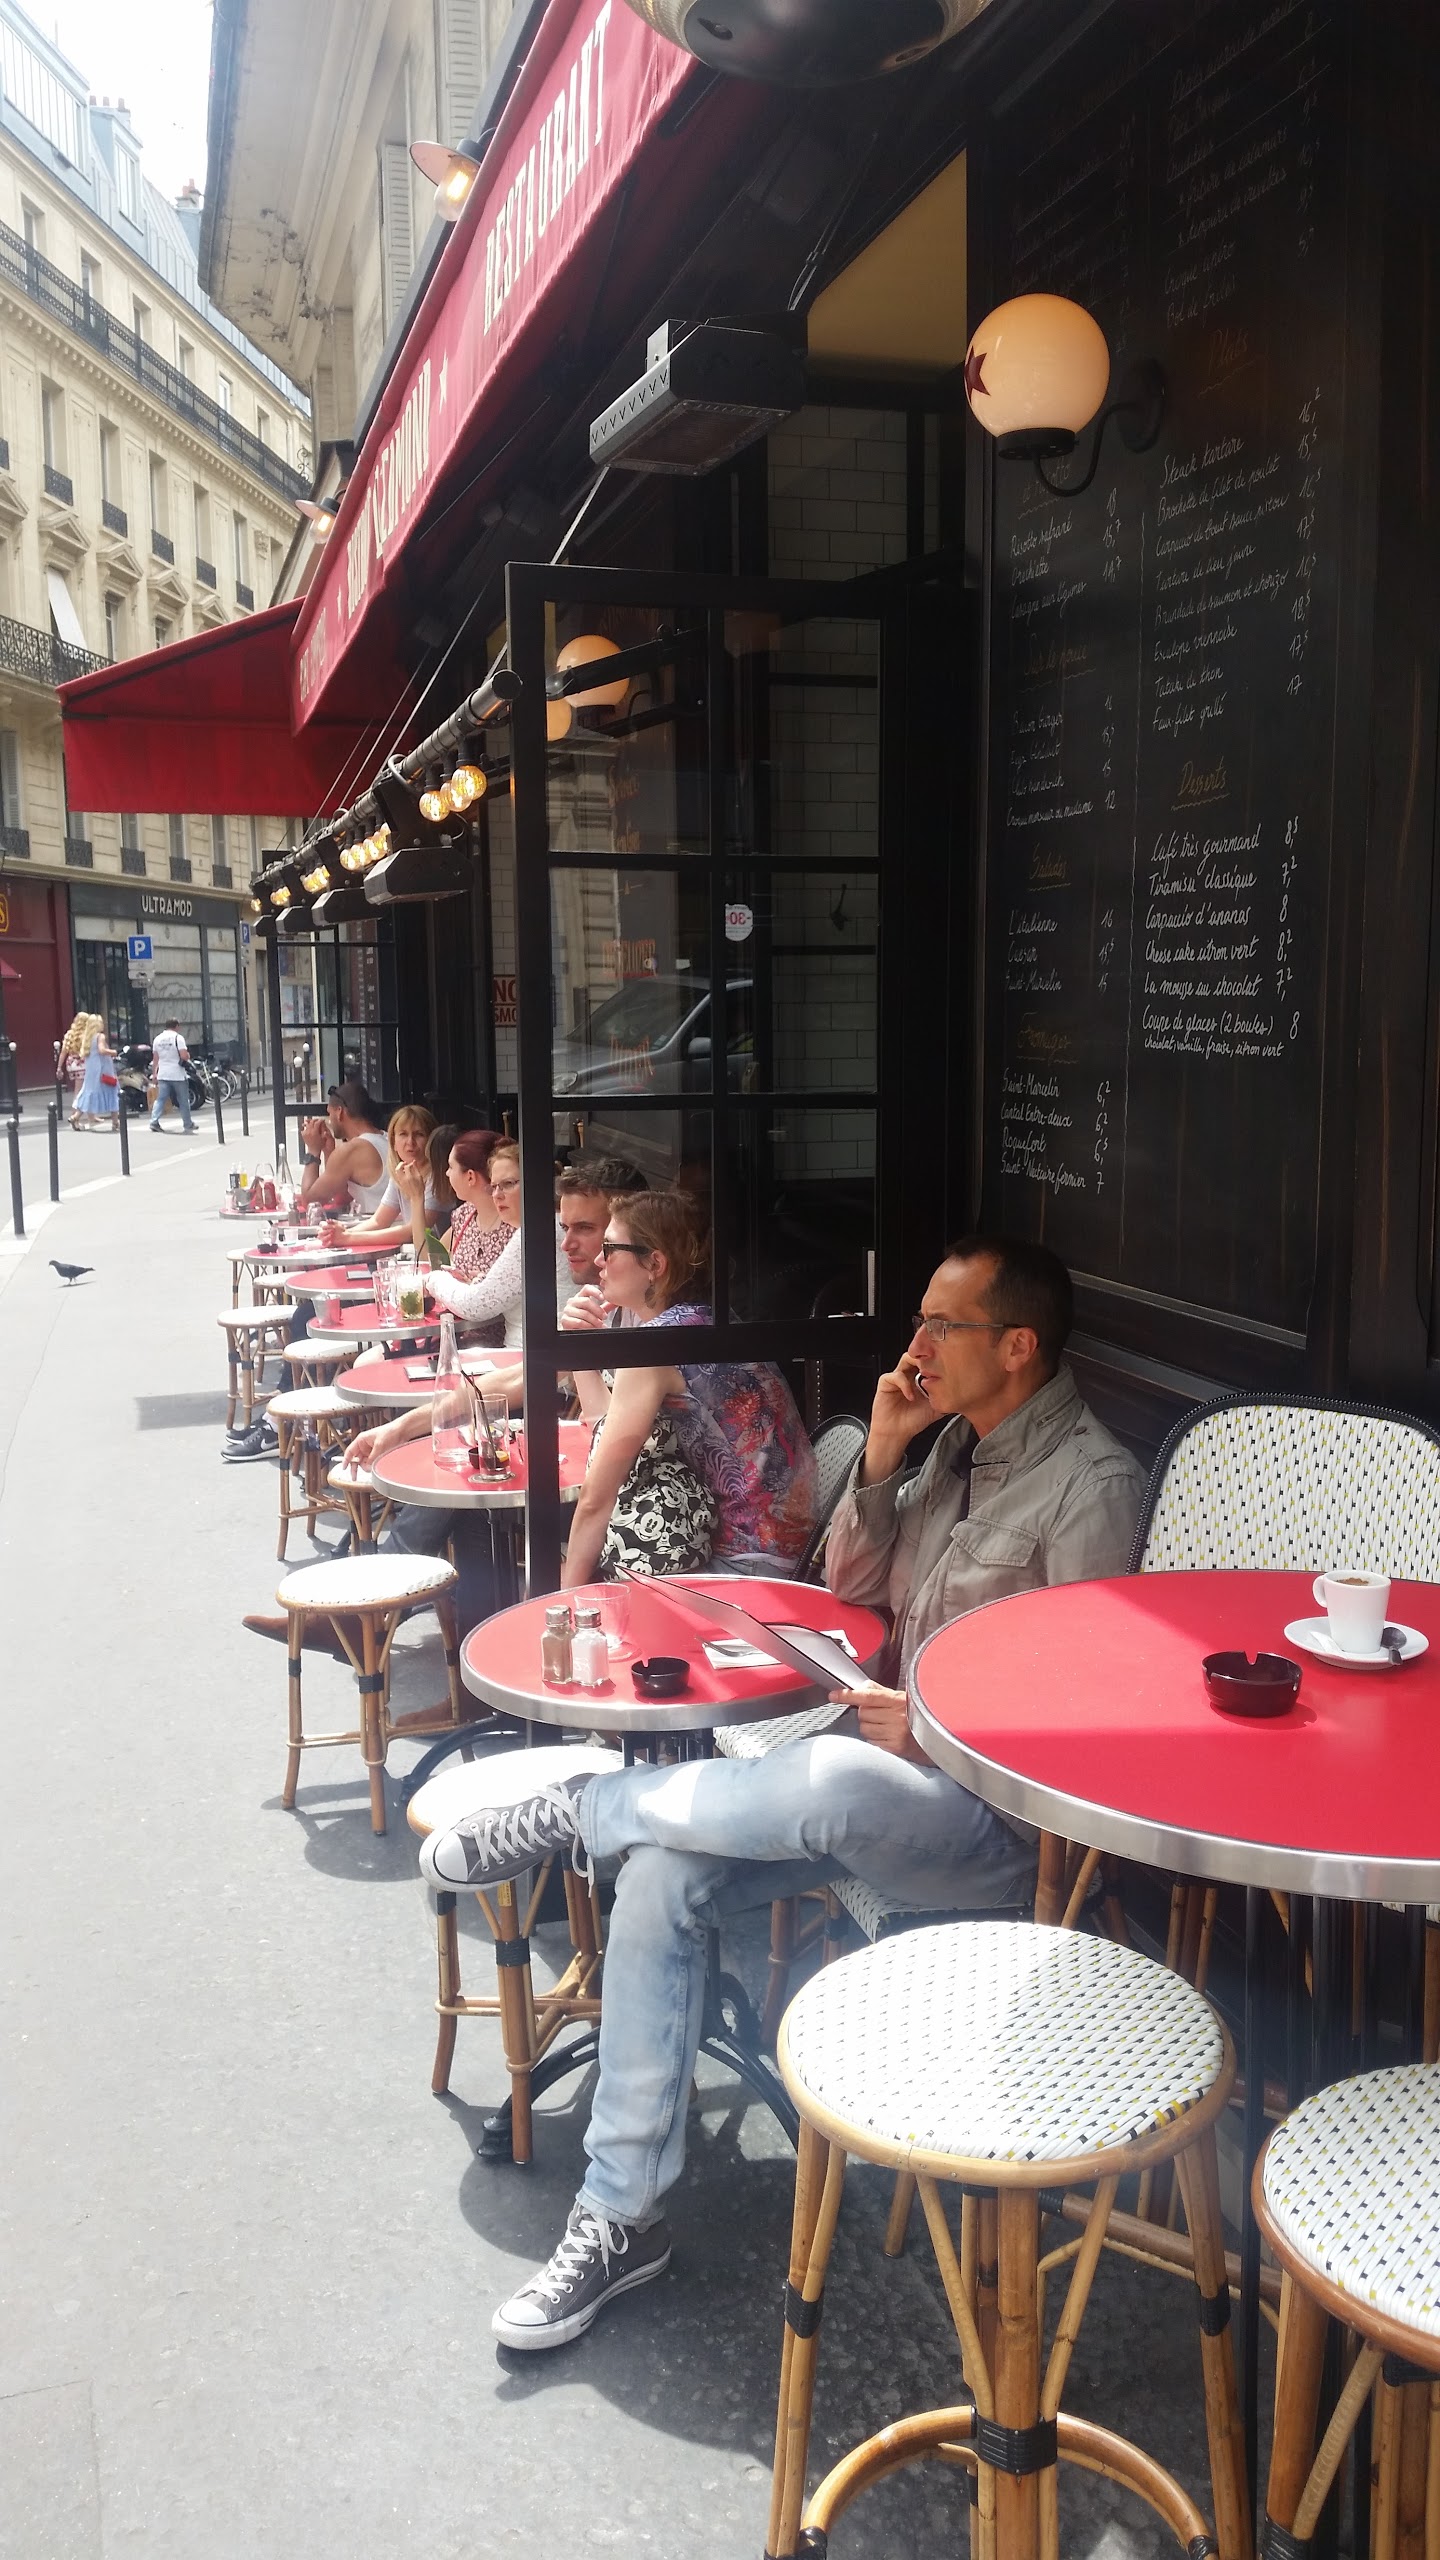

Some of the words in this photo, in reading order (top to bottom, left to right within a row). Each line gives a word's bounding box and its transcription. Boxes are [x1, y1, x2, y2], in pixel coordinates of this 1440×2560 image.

[483, 0, 613, 337] RESTAURANT
[1202, 437, 1244, 468] tartare
[1158, 490, 1196, 526] Brochette
[1199, 484, 1209, 505] de
[1210, 475, 1233, 510] filet
[1235, 469, 1245, 490] de
[1248, 453, 1280, 492] poulet
[1193, 560, 1204, 578] de
[1206, 553, 1225, 574] lieu
[1197, 590, 1207, 613] de
[1243, 578, 1253, 597] et
[1253, 568, 1289, 602] chorizo
[1154, 641, 1191, 662] Escalope
[1187, 670, 1197, 689] de
[1199, 662, 1223, 685] thon
[1153, 703, 1195, 737] Faux-filet
[1287, 675, 1302, 695] 17
[1178, 755, 1228, 796] Desserts
[1151, 830, 1178, 879] Café
[1180, 832, 1198, 858] très
[1197, 823, 1261, 876] gourmand
[1149, 872, 1197, 897] Tiramisu
[1205, 864, 1258, 901] classique
[142, 895, 193, 917] ULTRAMOD
[1145, 904, 1193, 940] Carpaccio
[1195, 902, 1251, 927] d'ananas
[1279, 894, 1288, 922] 8
[134, 940, 146, 956] P
[1145, 940, 1172, 963] Cheese
[1173, 941, 1195, 962] cake
[1197, 938, 1228, 962] citron
[1231, 935, 1259, 961] vert
[1144, 972, 1157, 994] La
[1160, 979, 1194, 1000] mousse
[1195, 981, 1211, 996] au
[1213, 974, 1263, 997] chocolat
[1142, 1004, 1171, 1039] Coupe
[1173, 1010, 1184, 1030] de
[1186, 1013, 1217, 1042] glaces
[1233, 1013, 1274, 1035] boules)
[1290, 1011, 1300, 1040] 8
[1235, 1041, 1260, 1056] citron
[1262, 1042, 1284, 1057] vert
[1002, 1067, 1060, 1098] Saint-Marcelin
[1000, 1101, 1024, 1121] Cantal
[1002, 1126, 1046, 1166] Roquefort
[1096, 1171, 1104, 1194] 7
